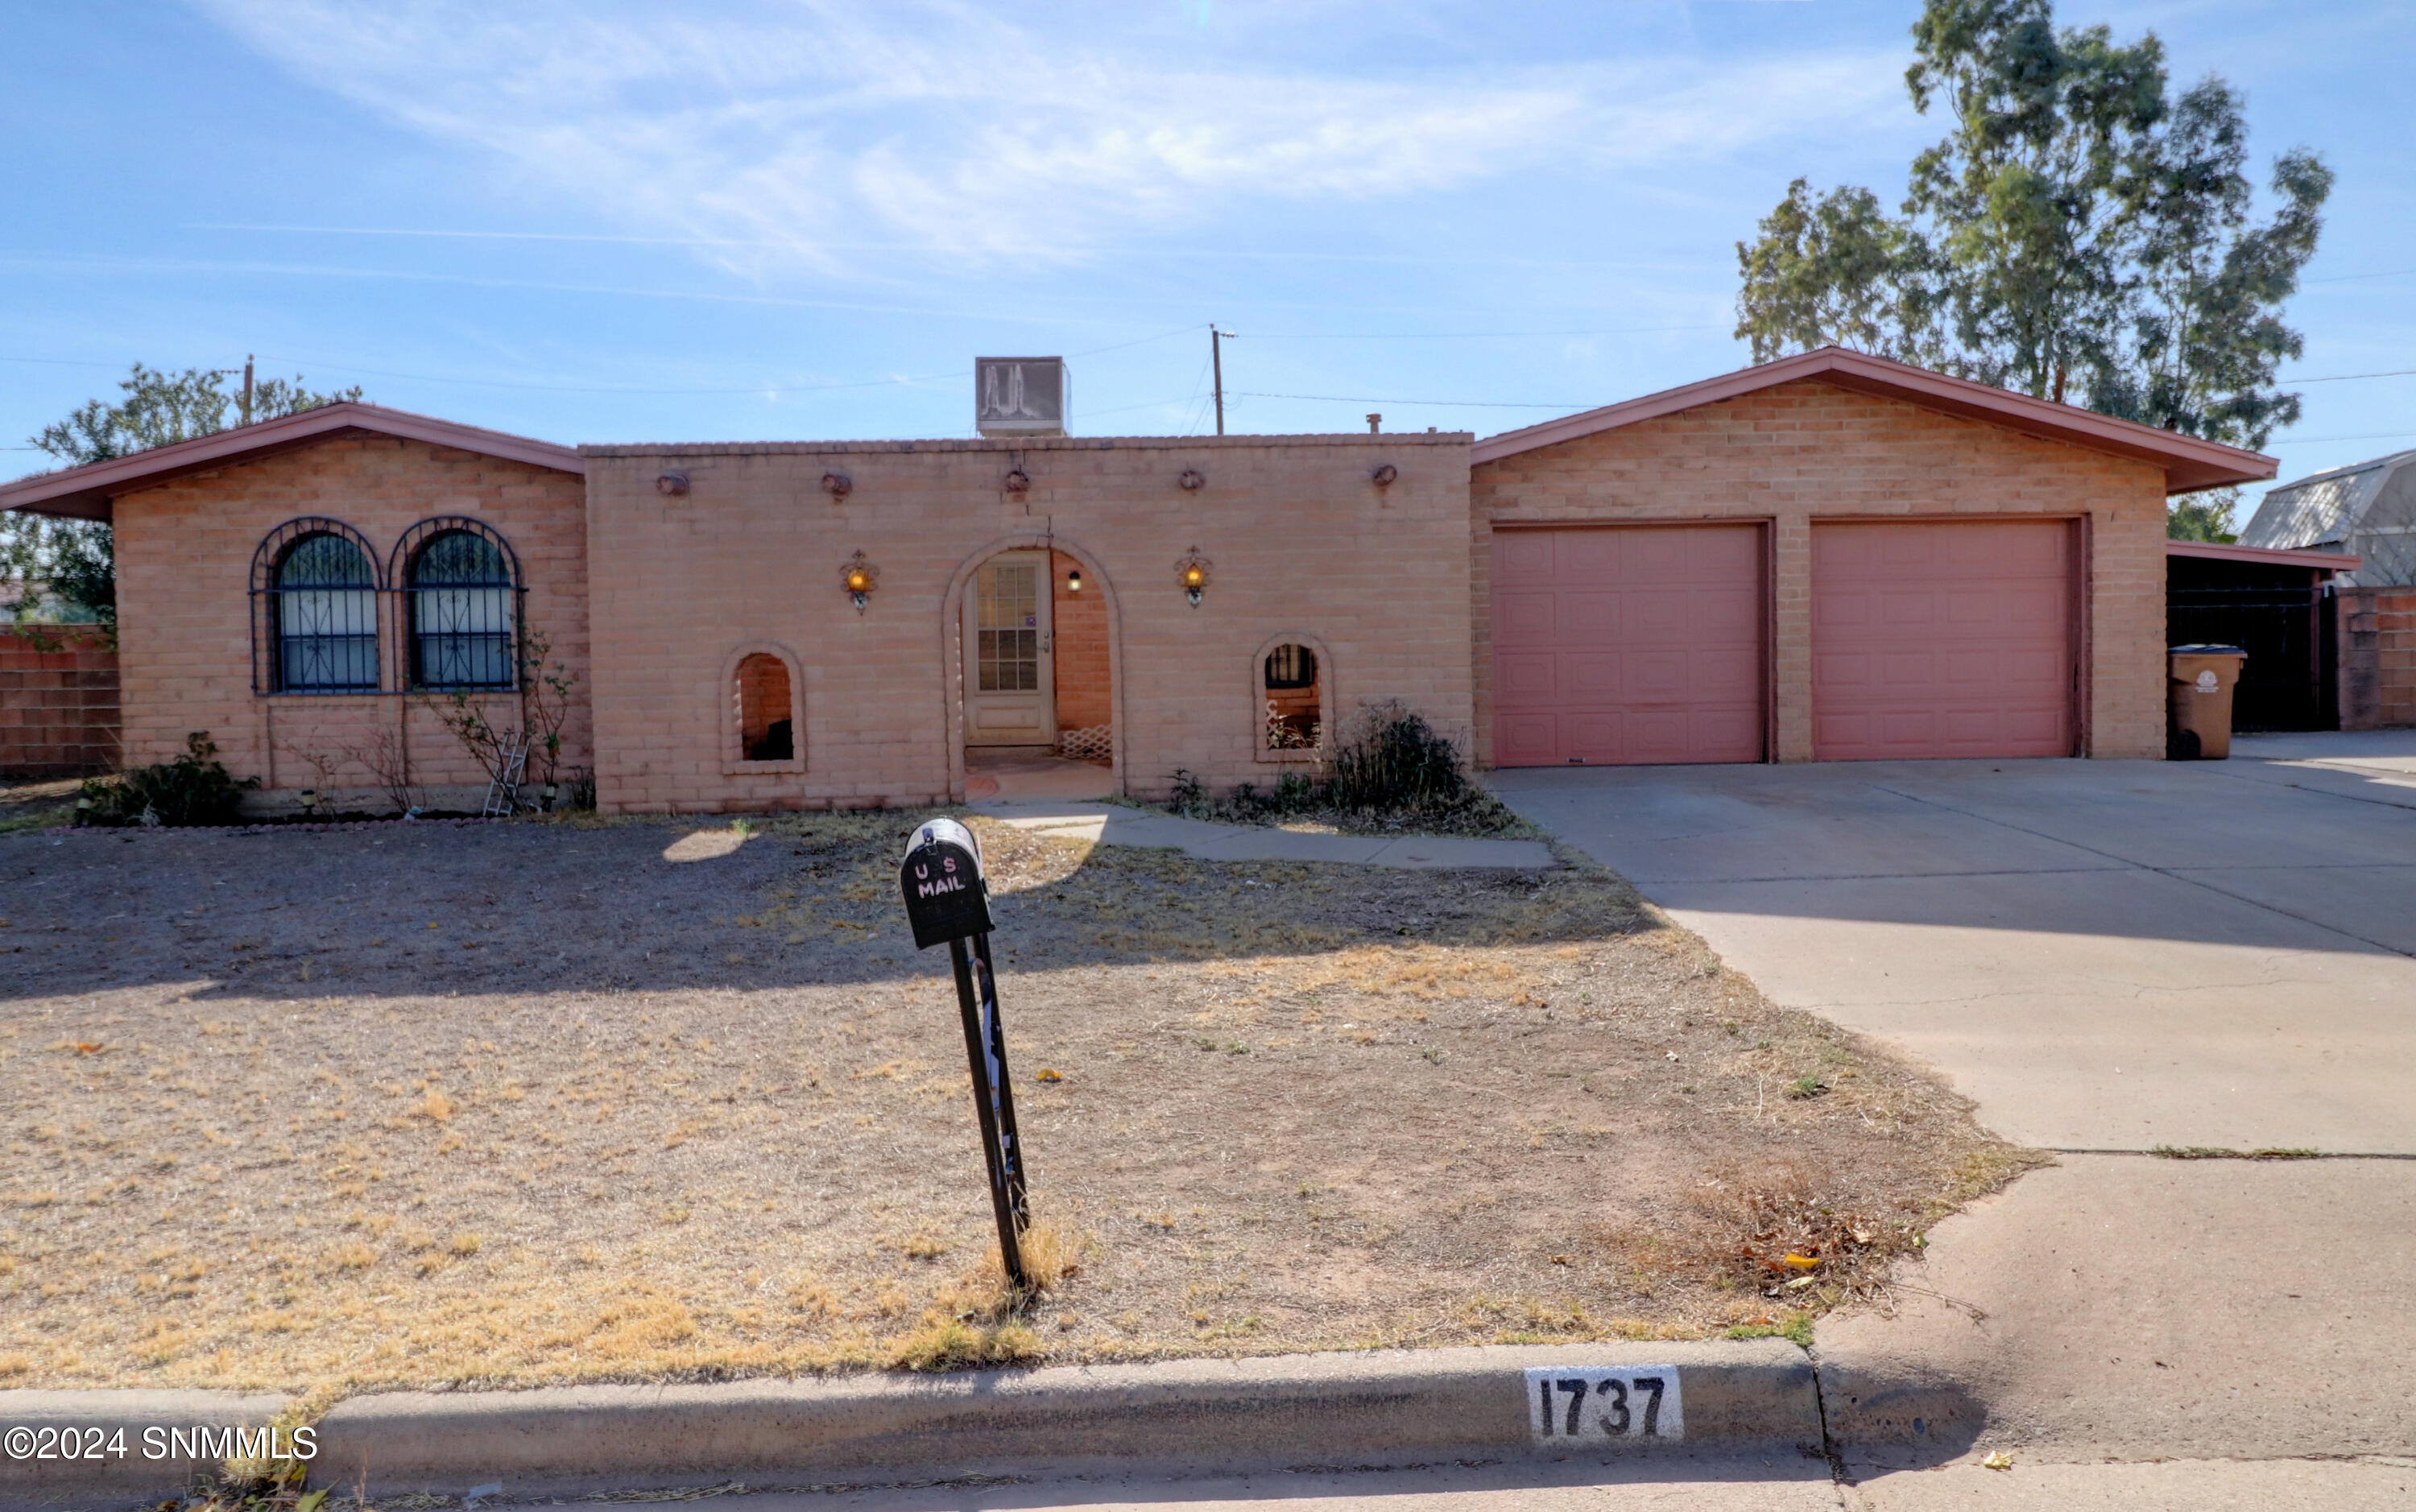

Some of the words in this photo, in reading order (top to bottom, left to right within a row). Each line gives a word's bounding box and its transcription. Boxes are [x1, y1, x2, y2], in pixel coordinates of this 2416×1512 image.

[915, 863, 928, 879] U
[943, 857, 957, 873] S
[918, 876, 966, 899] MAIL
[1541, 1377, 1665, 1436] 1737
